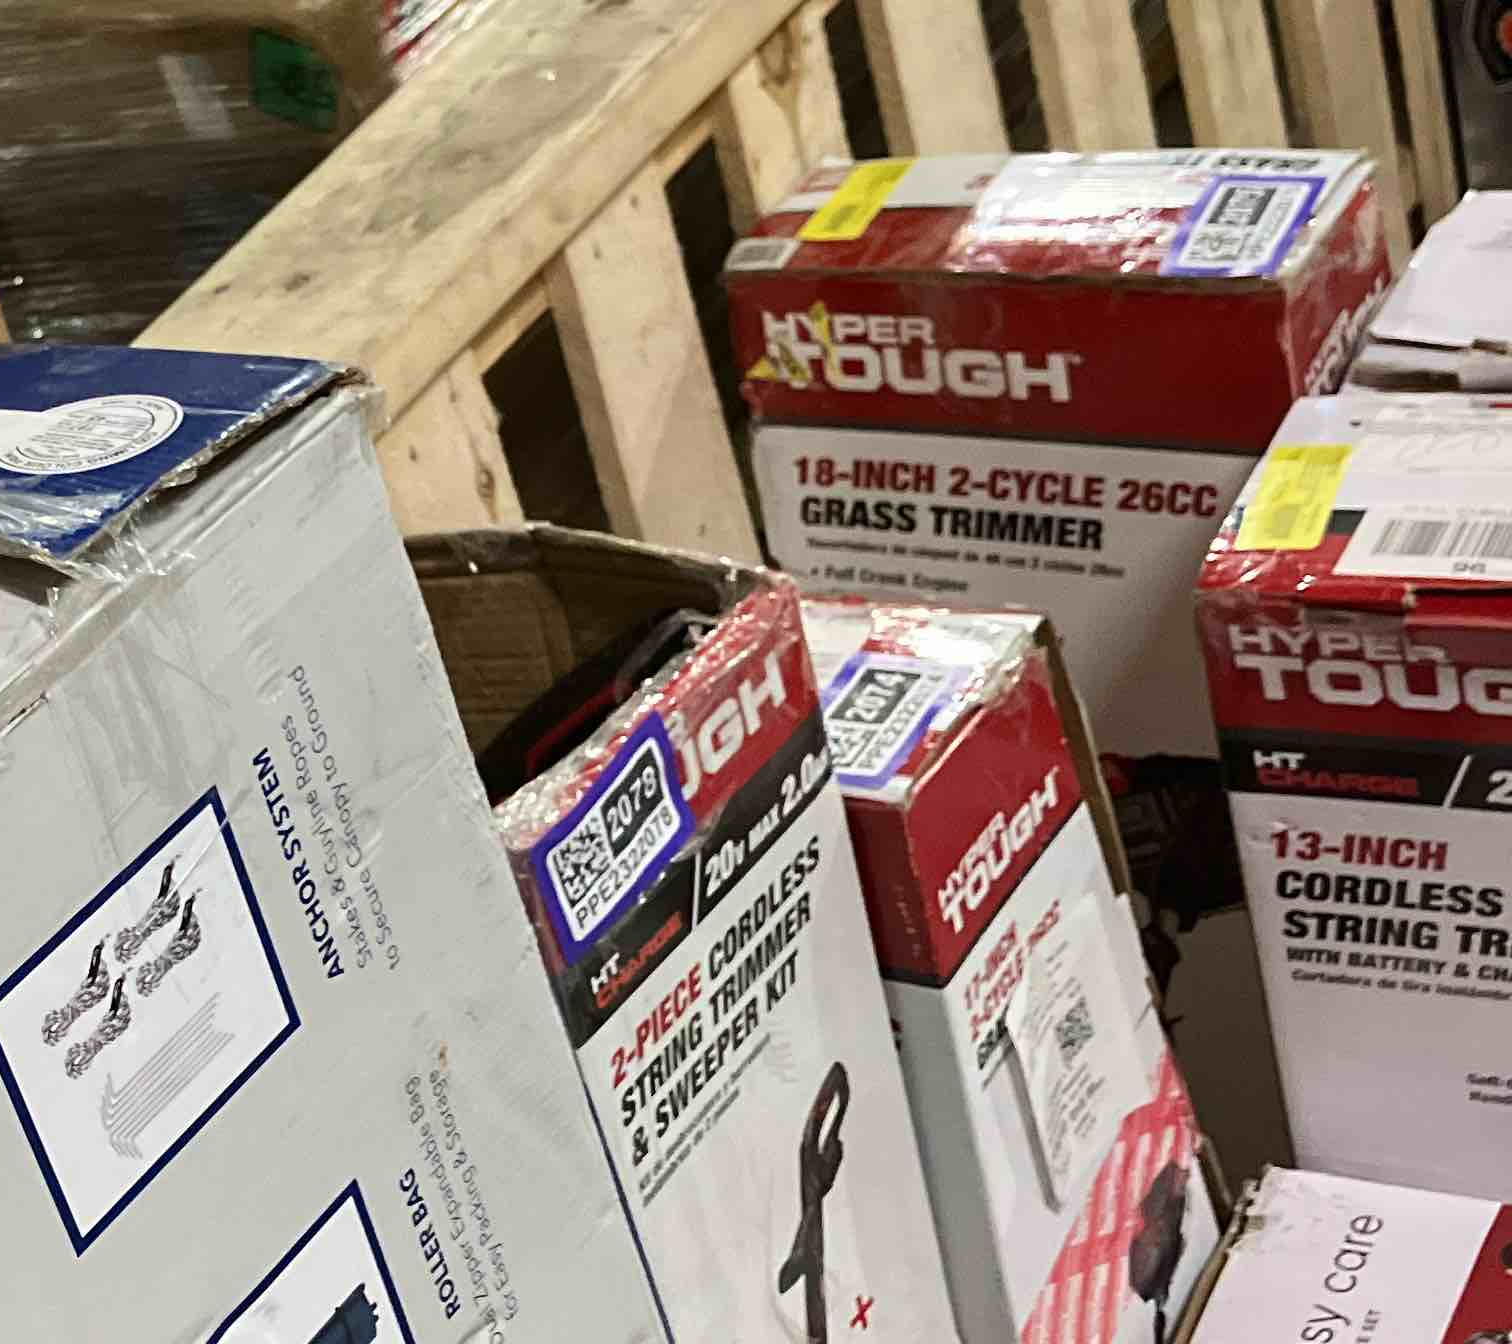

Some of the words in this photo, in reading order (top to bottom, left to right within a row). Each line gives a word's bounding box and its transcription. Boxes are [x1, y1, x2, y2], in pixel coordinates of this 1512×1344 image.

[761, 311, 935, 346] HYPER
[781, 344, 1076, 403] TOUGH
[794, 457, 935, 493] 18-INCH
[949, 468, 1104, 508] 2-CYCLE
[1117, 480, 1217, 517] 26CC
[801, 498, 917, 532] GRASS
[930, 506, 1104, 550] TRIMMER
[1229, 624, 1448, 663] HYPER
[285, 664, 334, 754] Ground
[272, 713, 318, 790] Ropes
[317, 753, 341, 780] to
[1253, 750, 1305, 770] HT
[248, 747, 307, 860] SYSTEM
[297, 788, 348, 876] Guyline
[321, 781, 375, 869] Canopy
[601, 766, 662, 842] 2078
[326, 875, 349, 896] &
[571, 808, 677, 930] PPE2322078
[939, 764, 1059, 935] TOUGH
[1271, 829, 1448, 872] 13-INCH
[287, 860, 348, 980] ANCHOR
[352, 867, 397, 946] Secure
[1275, 870, 1504, 916] CORDLESS
[334, 895, 378, 970] Stakes
[381, 944, 404, 971] to
[600, 961, 708, 1089] 2-PIECE
[696, 835, 826, 982] CORDLESS
[1282, 910, 1439, 952] STRING
[1455, 925, 1512, 957] TR
[1287, 947, 1341, 965] WITH
[1347, 952, 1447, 975] BATTERY
[1454, 963, 1470, 977] &
[611, 1012, 710, 1127] STRING
[702, 891, 815, 1027] TRIMMER
[620, 1125, 656, 1167] &
[644, 999, 766, 1139] SWEEPER
[756, 951, 803, 1014] KIT
[397, 1074, 435, 1125] Bag
[420, 1067, 470, 1152] Storage
[395, 1167, 432, 1227] BAG
[454, 1165, 501, 1245] Packing
[416, 1226, 465, 1319] ROLLER
[480, 1241, 518, 1292] Easy
[1322, 1212, 1385, 1295] care
